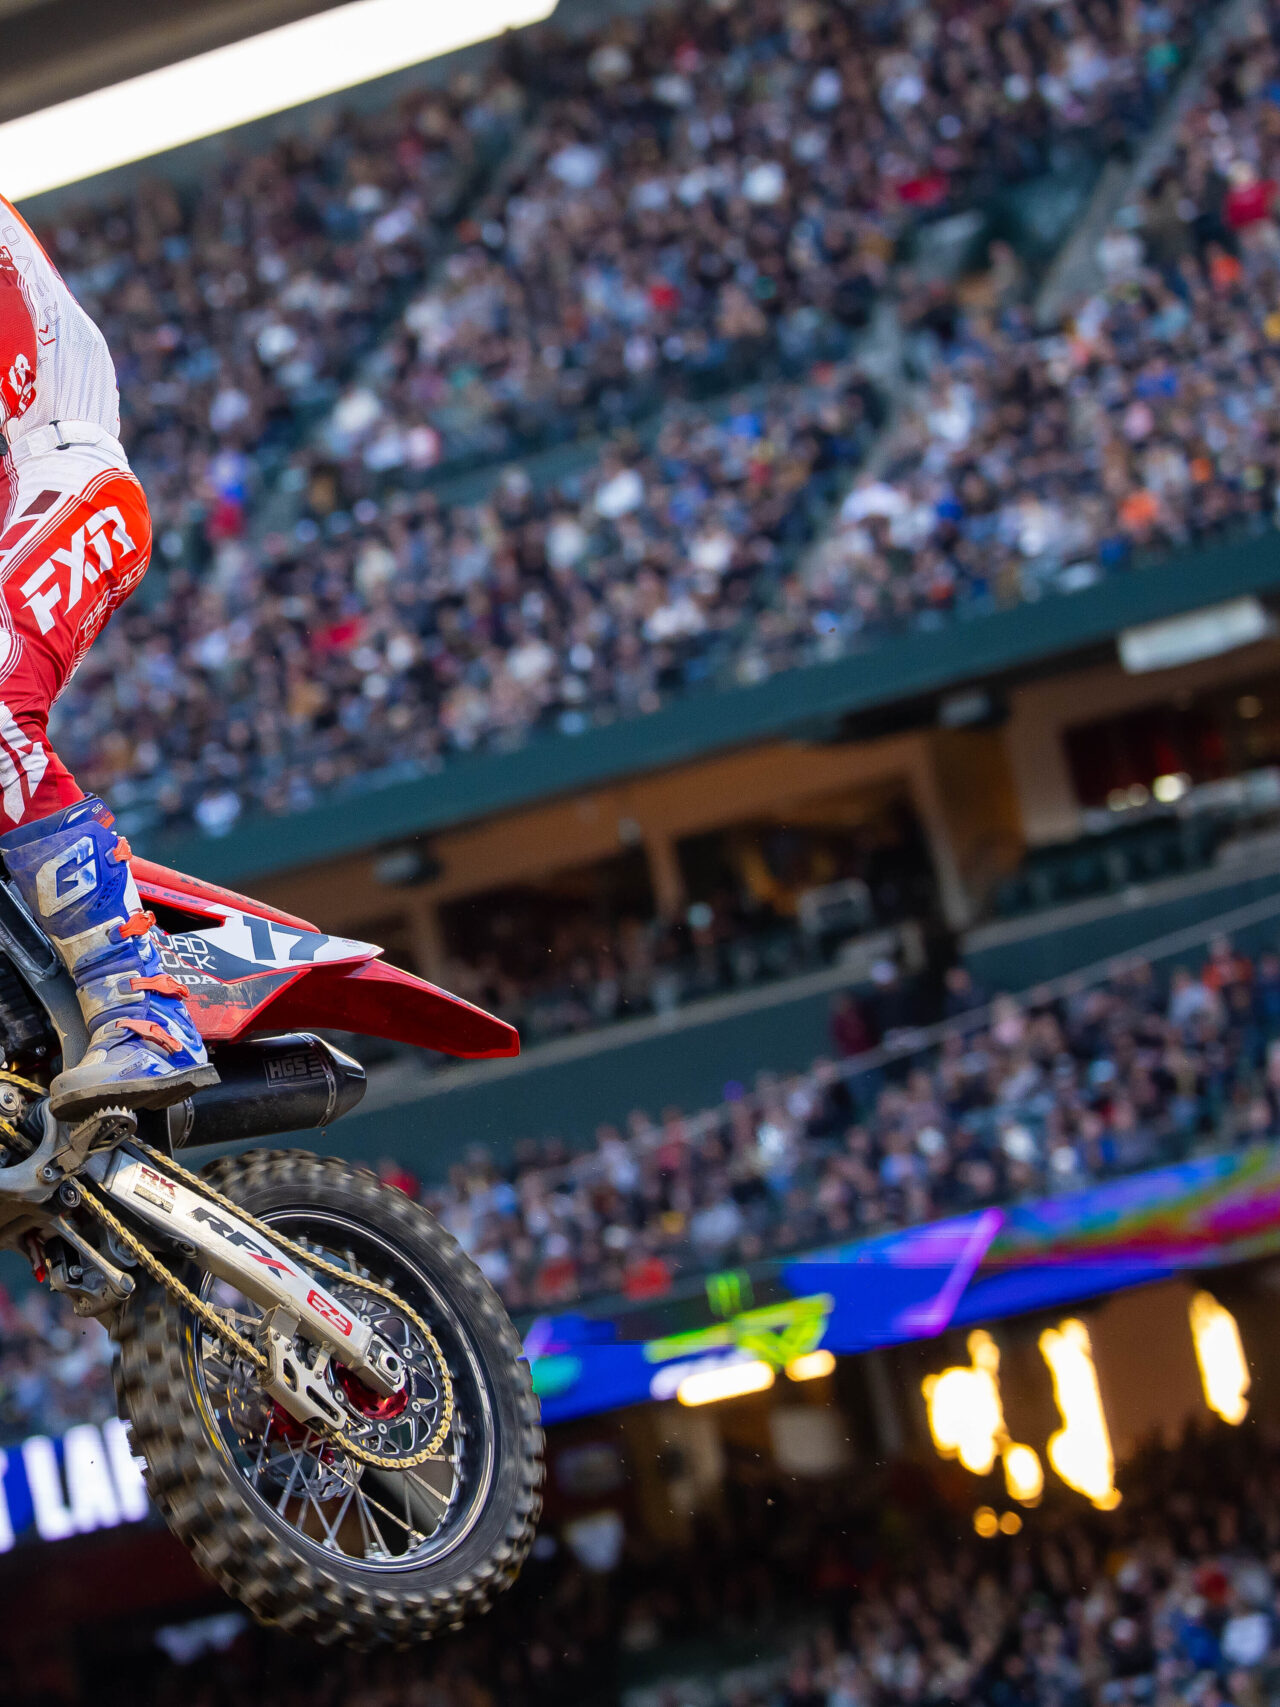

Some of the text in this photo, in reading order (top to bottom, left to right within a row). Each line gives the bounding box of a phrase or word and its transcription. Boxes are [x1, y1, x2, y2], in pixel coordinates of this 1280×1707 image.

[20, 506, 136, 636] FXR
[242, 915, 329, 961] 17
[158, 950, 217, 971] OCK
[169, 973, 221, 985] NDA
[267, 1056, 308, 1079] HGS
[140, 1166, 178, 1199] RK
[187, 1206, 298, 1280] RFX
